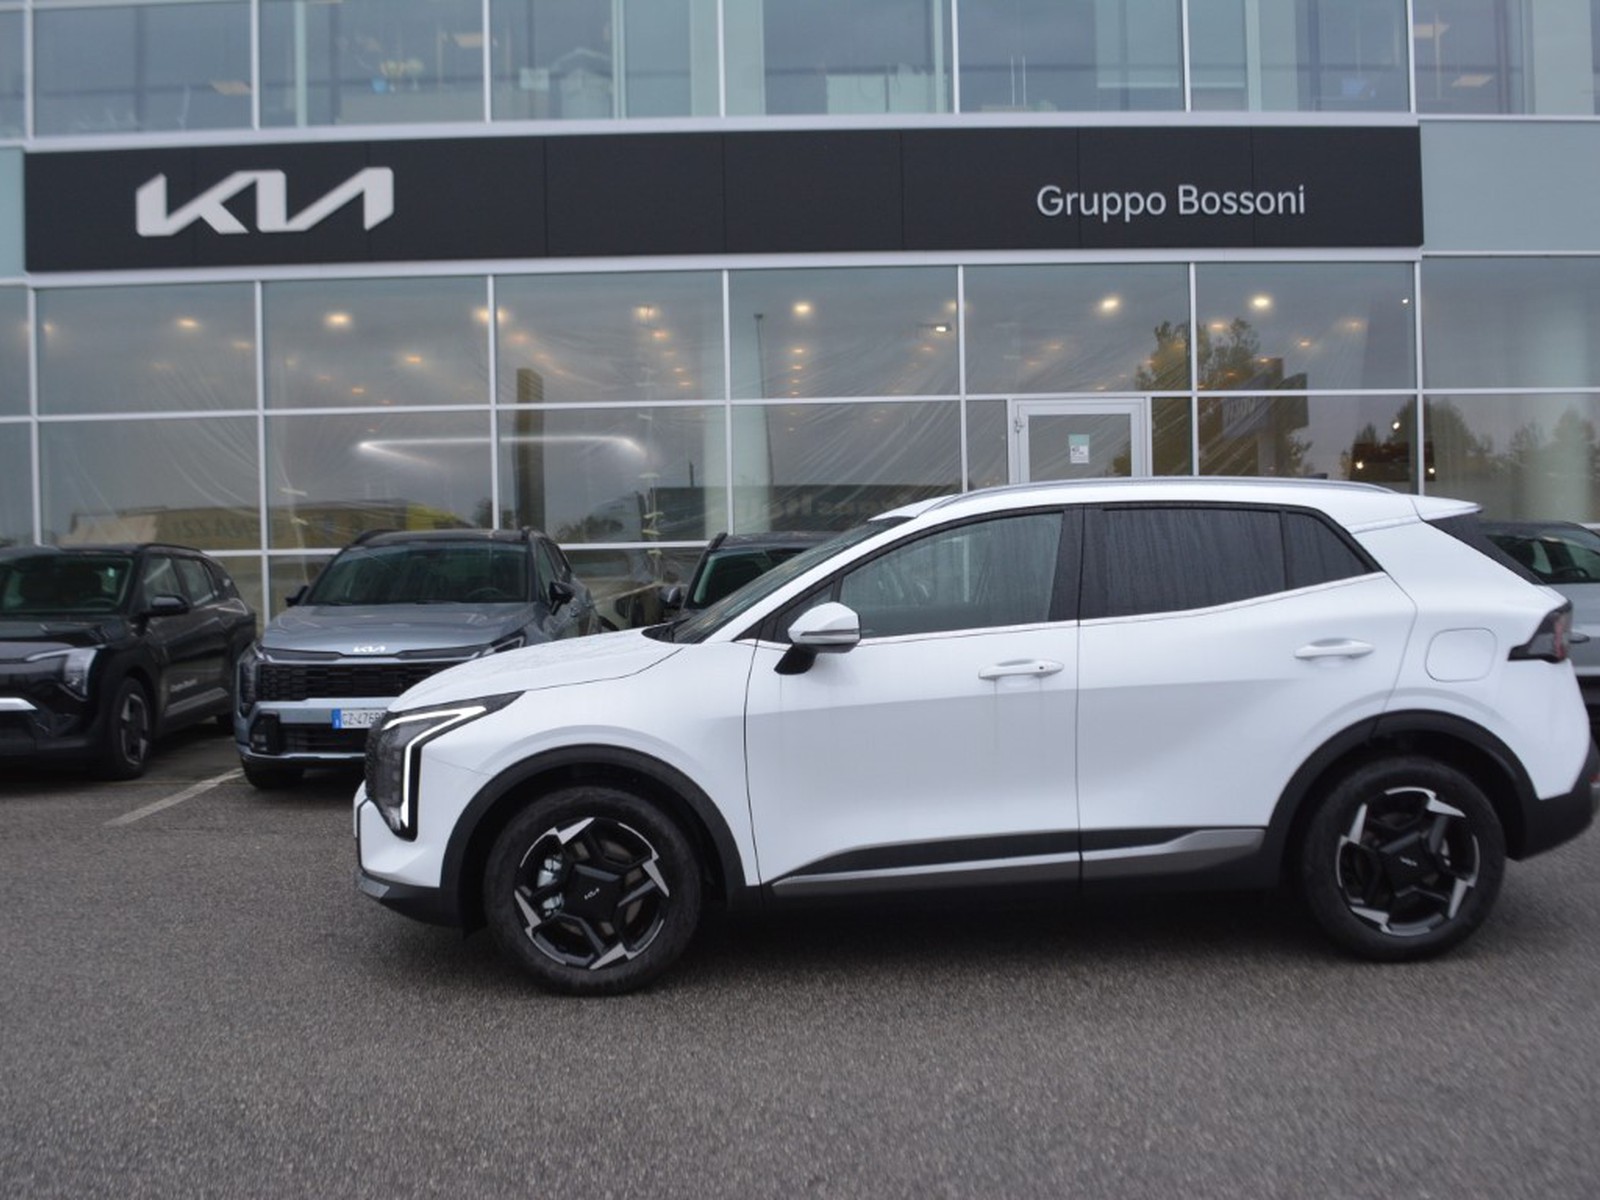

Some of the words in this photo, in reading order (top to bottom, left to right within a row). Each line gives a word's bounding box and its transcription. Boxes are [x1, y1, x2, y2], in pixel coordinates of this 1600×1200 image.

[135, 166, 394, 237] KIA
[1037, 184, 1167, 223] Gruppo
[1177, 184, 1306, 215] Bossoni
